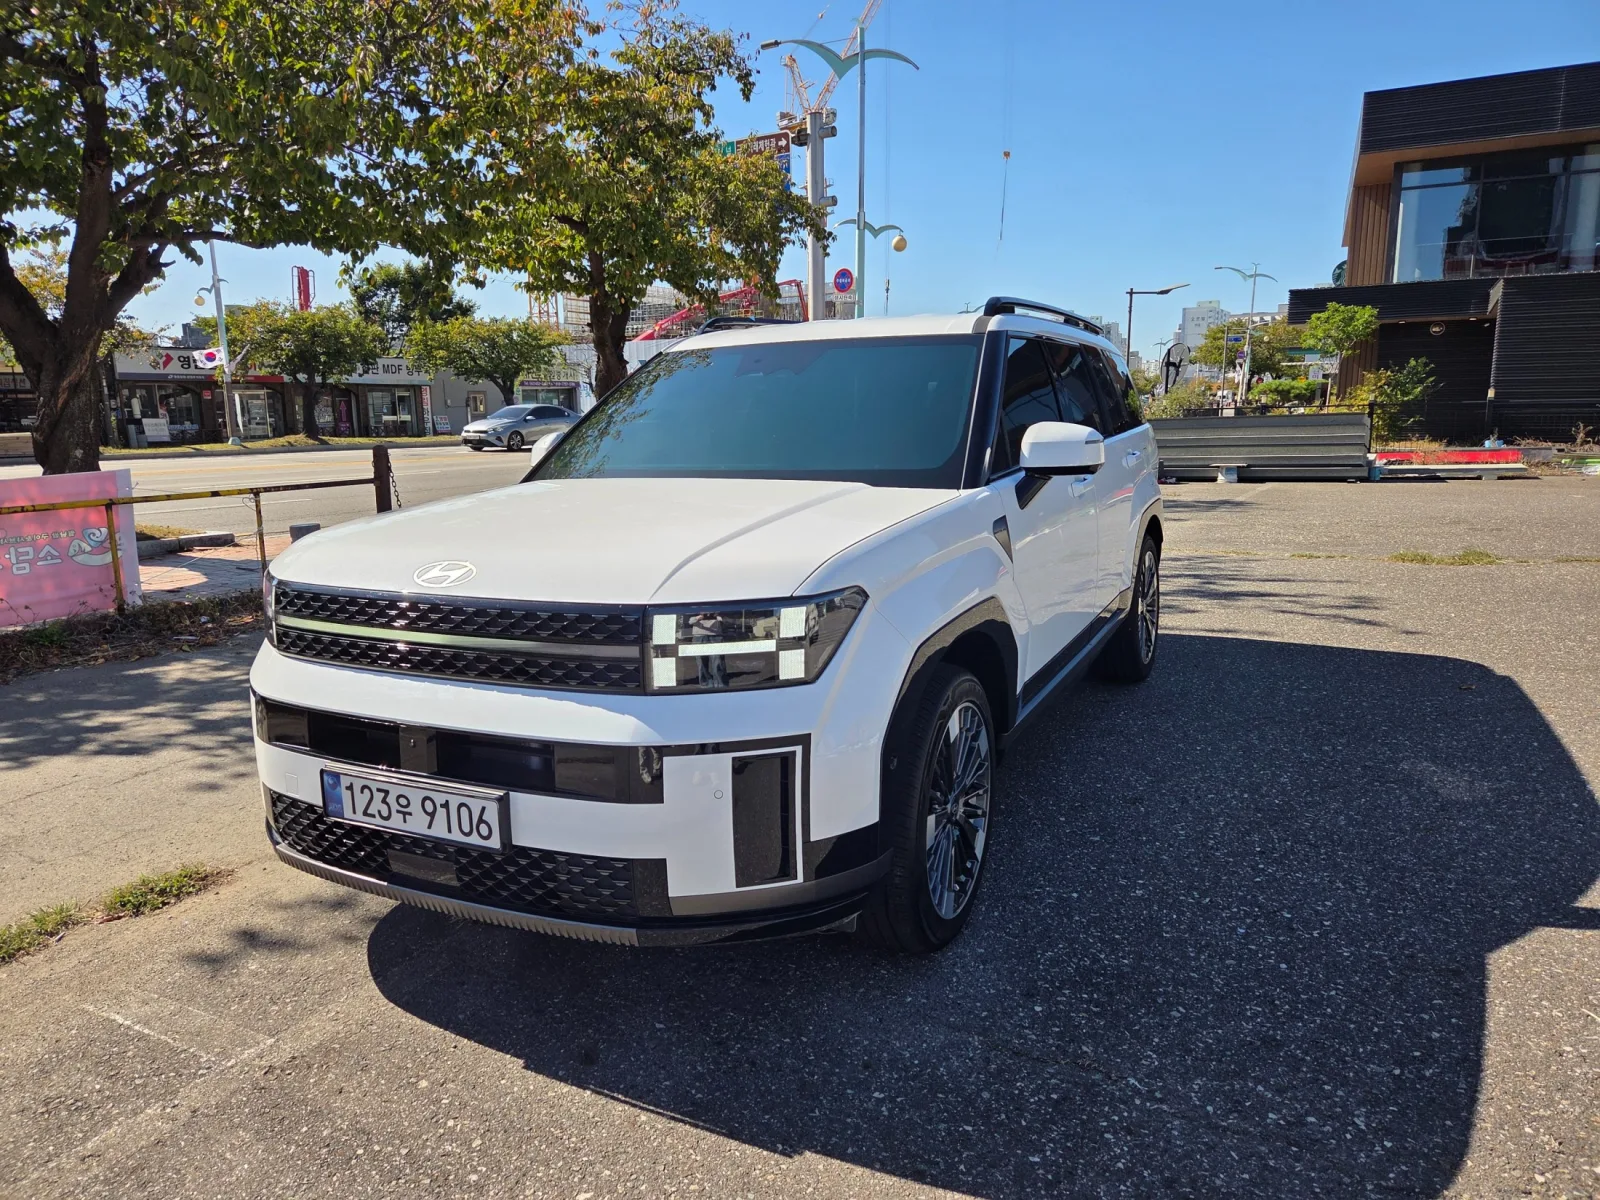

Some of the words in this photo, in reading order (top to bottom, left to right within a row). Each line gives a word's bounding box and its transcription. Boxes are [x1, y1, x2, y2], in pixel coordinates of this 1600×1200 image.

[382, 363, 402, 375] MDF
[345, 781, 413, 824] 123우
[420, 795, 493, 842] 9106
